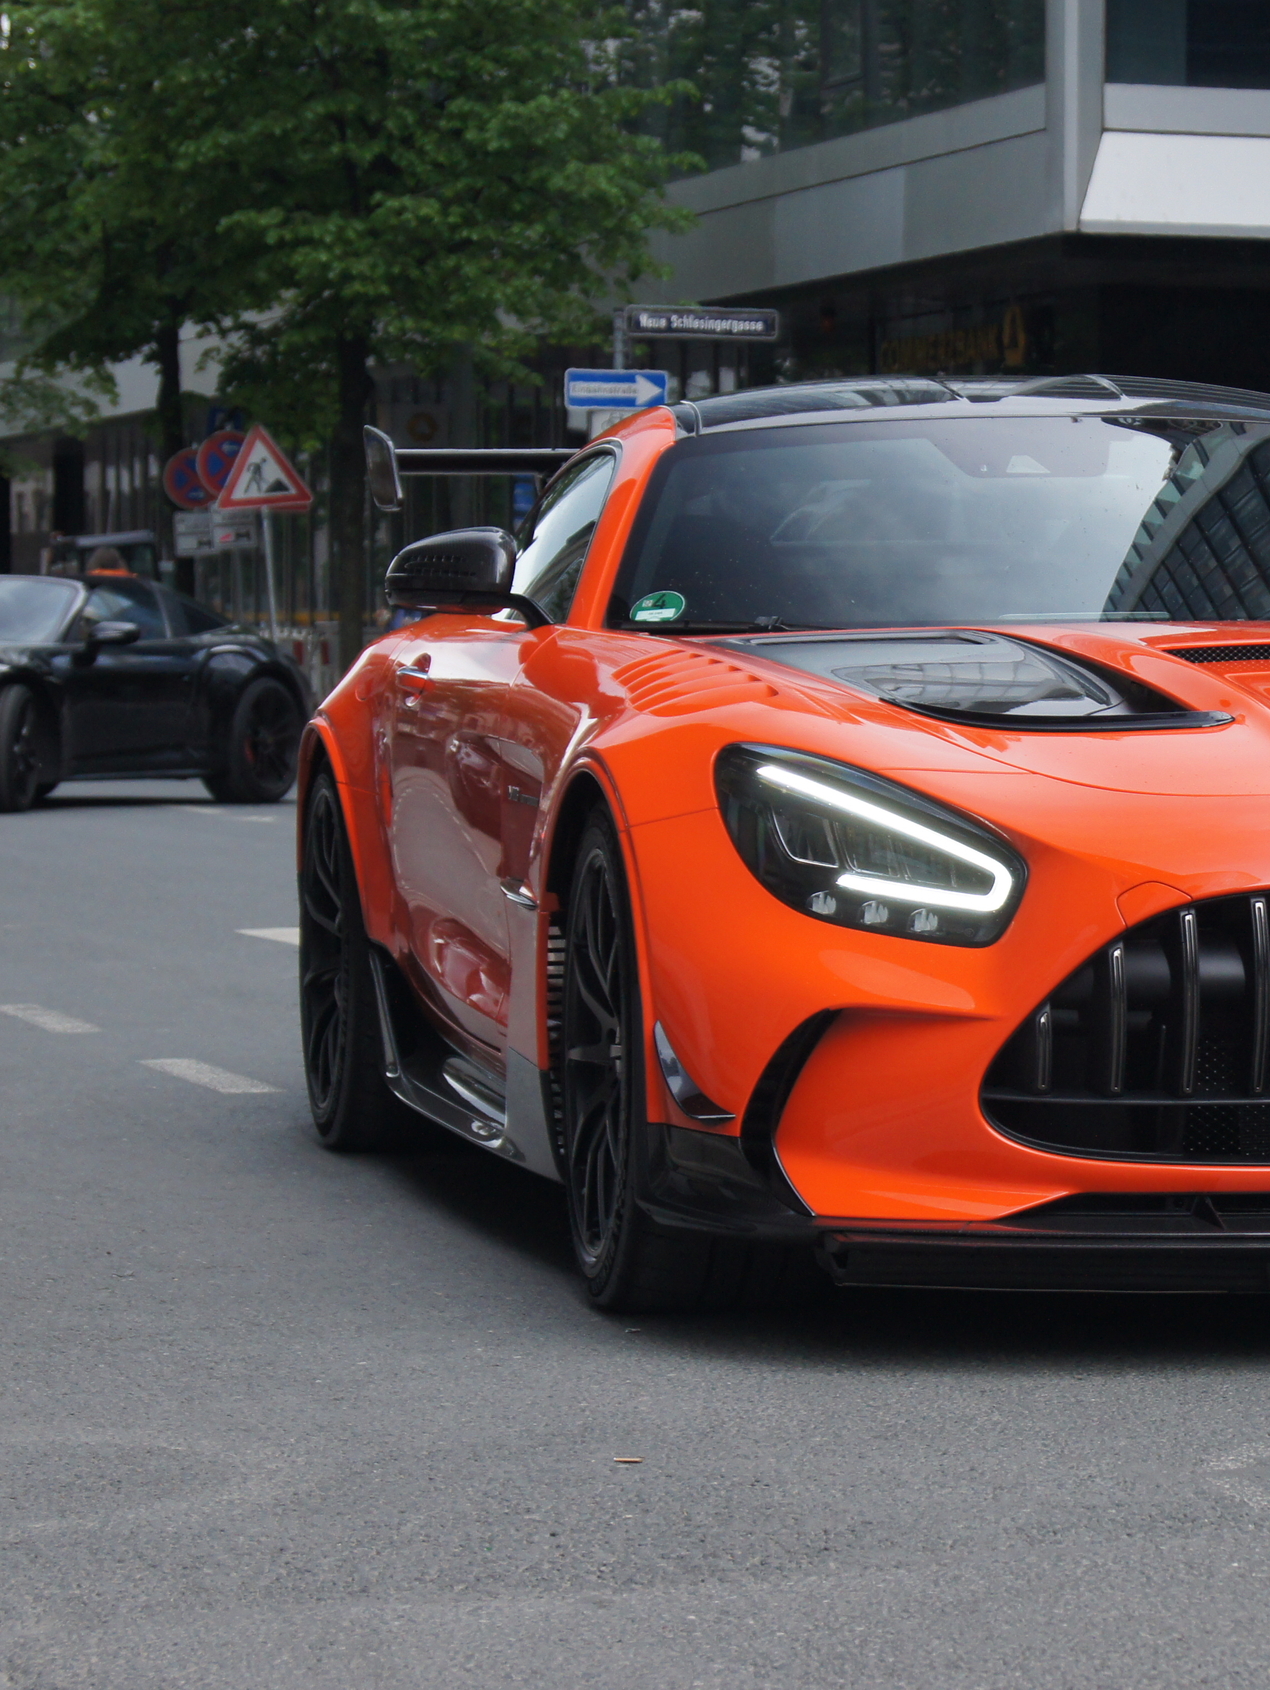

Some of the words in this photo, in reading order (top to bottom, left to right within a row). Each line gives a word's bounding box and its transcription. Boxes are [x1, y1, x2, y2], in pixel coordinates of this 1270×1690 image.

[639, 313, 667, 329] Neue
[670, 314, 765, 333] Schlesingergasse
[652, 593, 667, 609] 4
